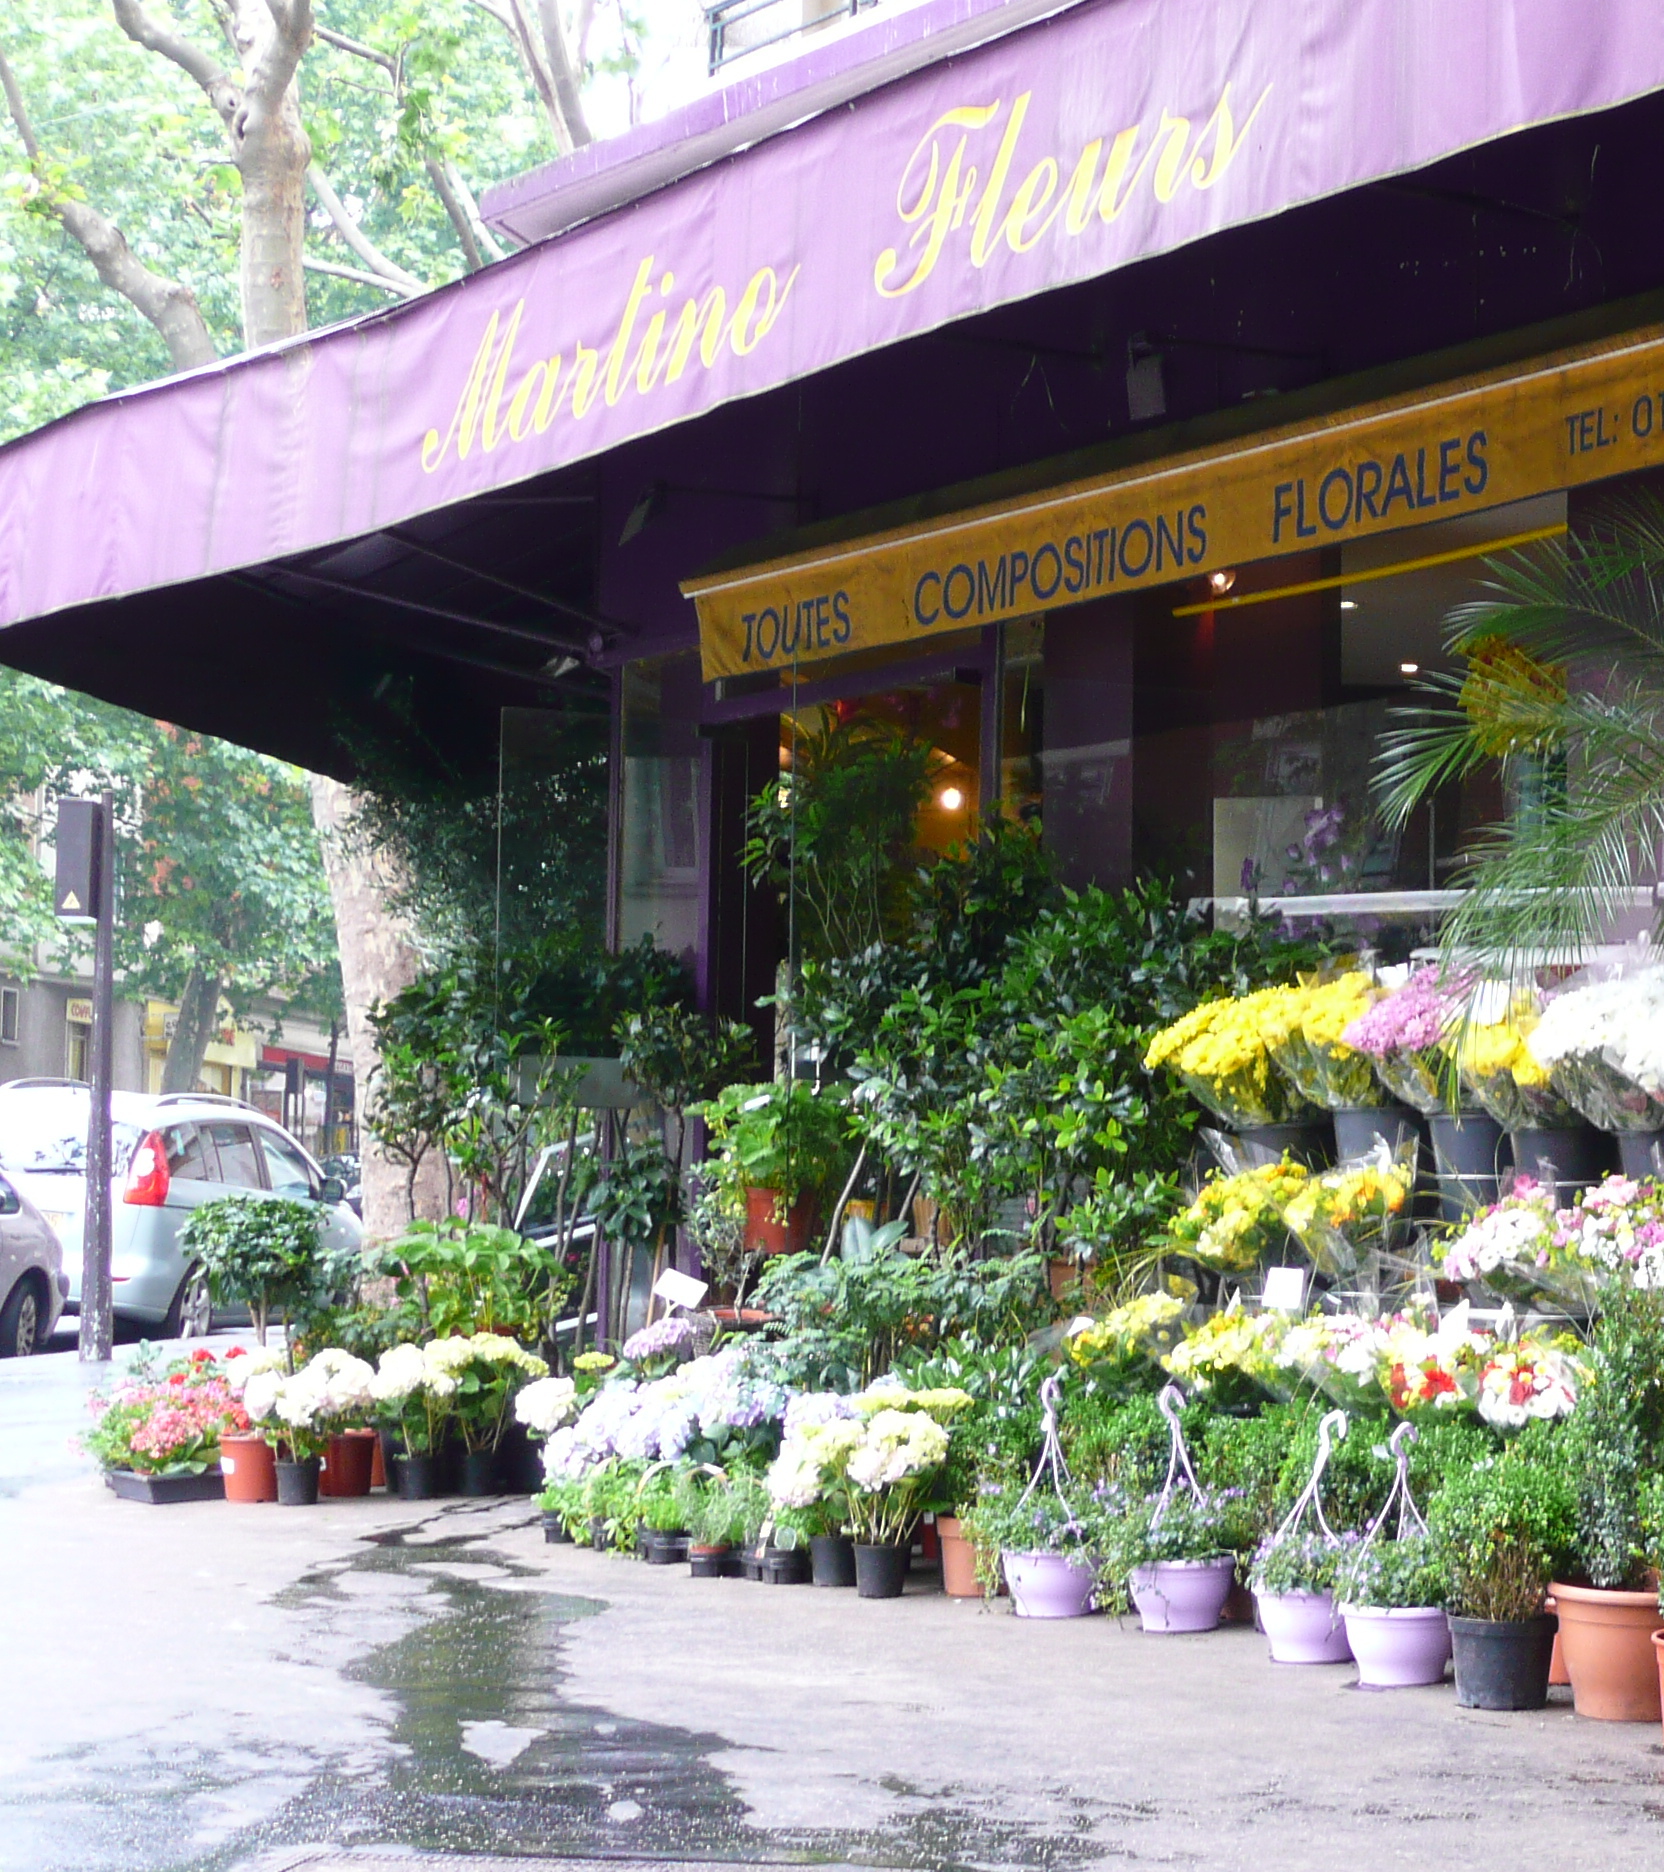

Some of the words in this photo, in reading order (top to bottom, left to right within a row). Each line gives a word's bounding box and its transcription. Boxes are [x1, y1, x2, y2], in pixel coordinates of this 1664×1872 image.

[421, 254, 801, 474] Martino
[874, 82, 1273, 298] Fleurs
[741, 590, 851, 662] TOUTES
[914, 504, 1207, 626] COMPOSITIONS
[1271, 430, 1489, 544] FLORALES
[1565, 406, 1619, 455] TEL:
